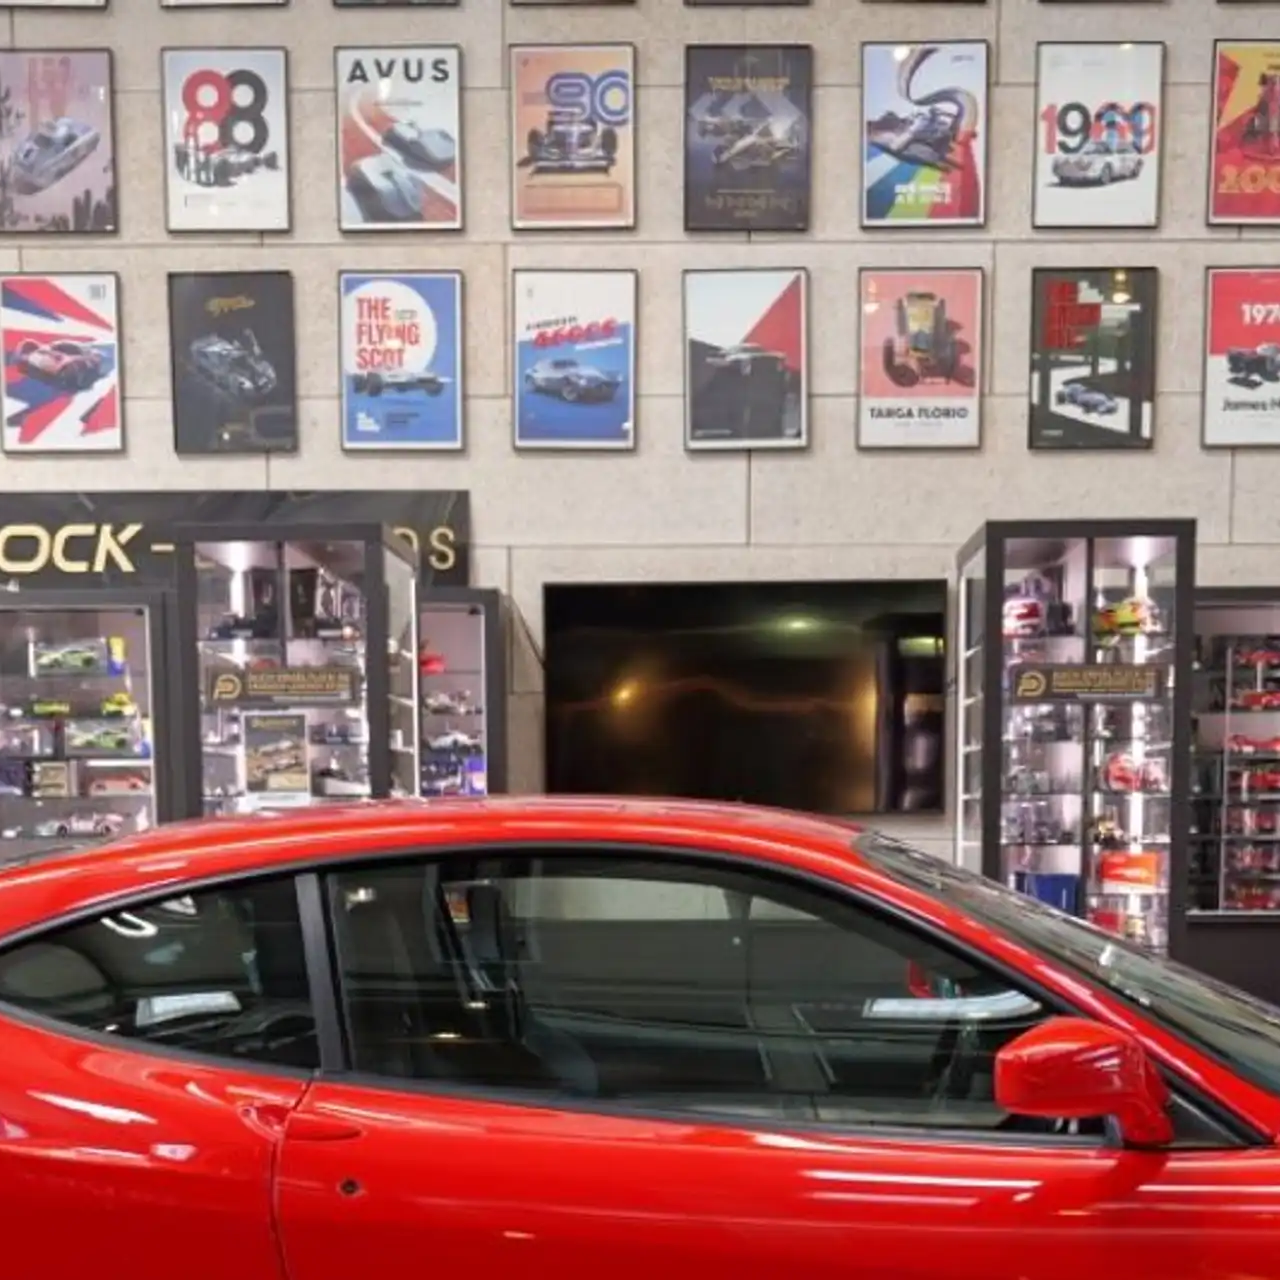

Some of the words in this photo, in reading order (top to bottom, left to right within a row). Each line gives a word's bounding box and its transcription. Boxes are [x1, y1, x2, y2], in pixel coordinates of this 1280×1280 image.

[347, 58, 451, 84] AVUS
[547, 71, 629, 126] 90
[182, 69, 269, 153] 88
[356, 297, 391, 319] THE
[356, 348, 405, 371] SCOT
[870, 407, 915, 419] TARGA
[1222, 397, 1268, 412] James
